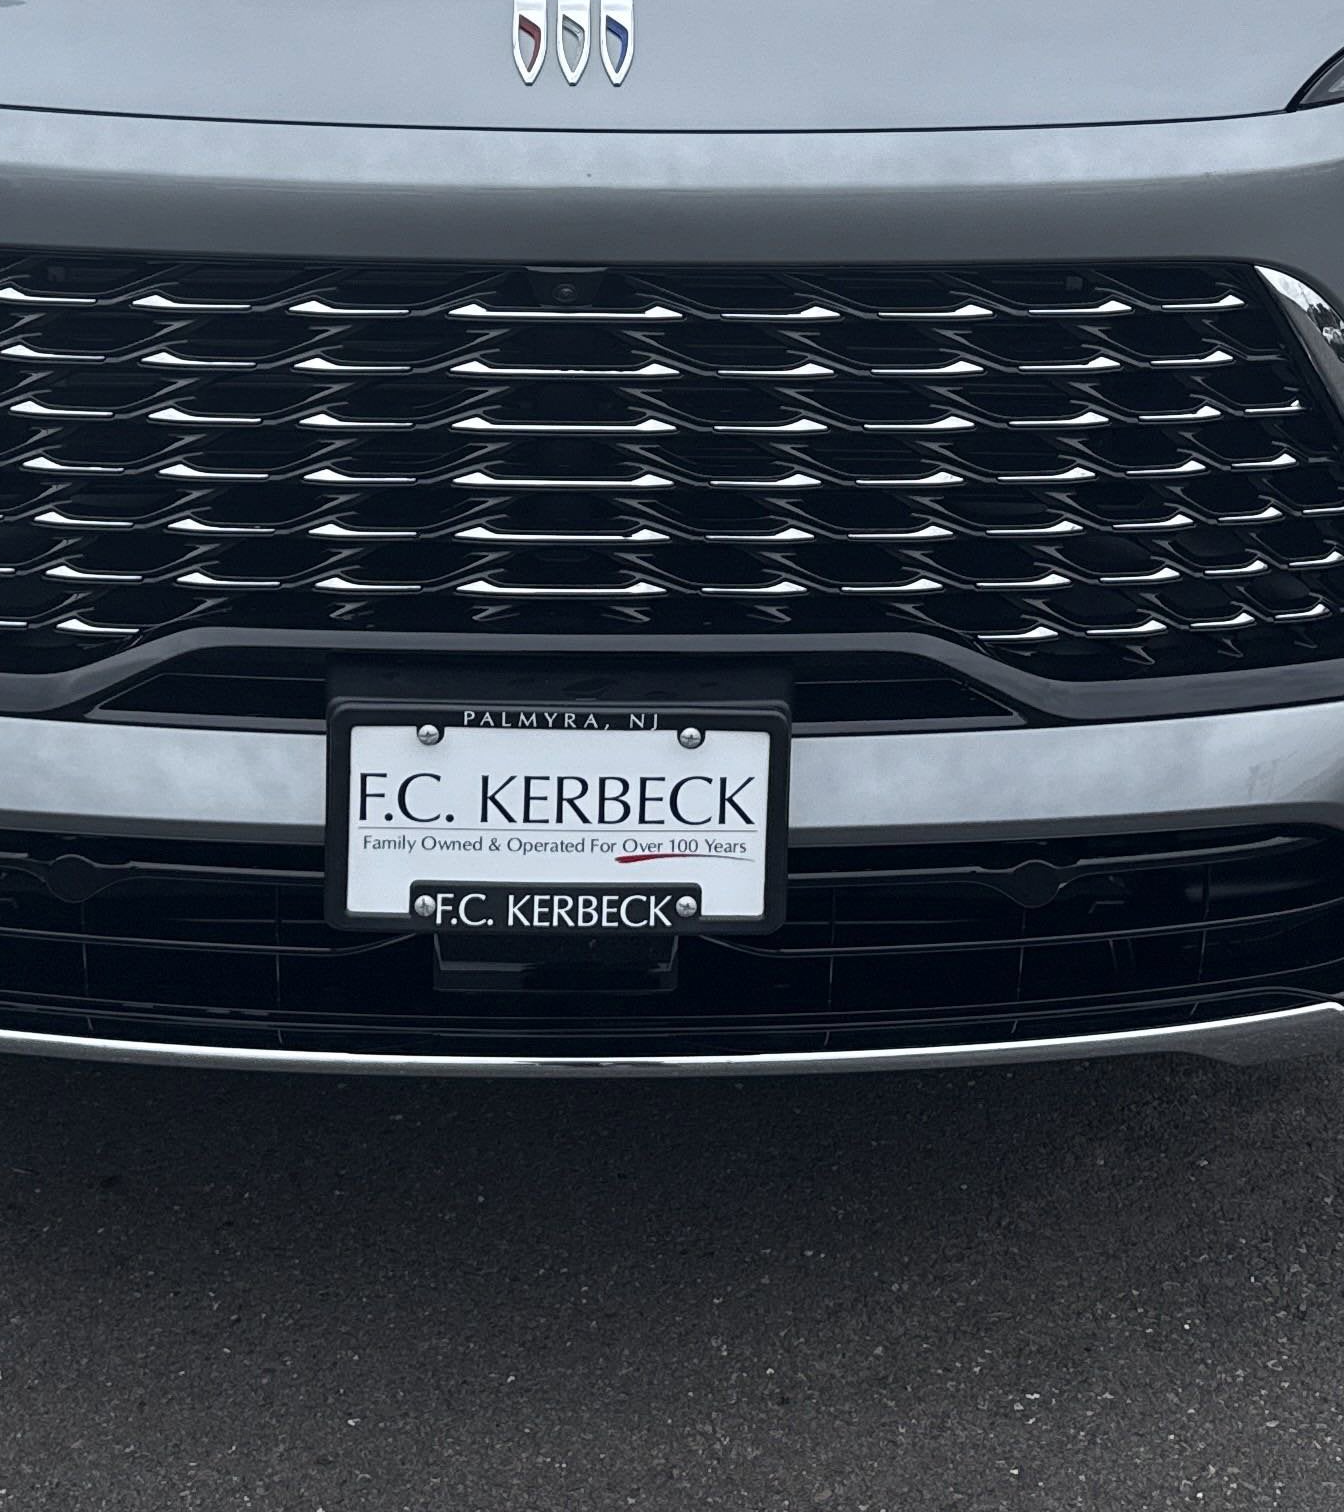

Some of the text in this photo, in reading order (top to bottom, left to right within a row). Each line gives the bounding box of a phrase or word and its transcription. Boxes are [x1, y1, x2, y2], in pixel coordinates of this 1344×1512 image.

[463, 711, 659, 731] PALMYRA, NJ
[359, 773, 756, 826] F.C. KERBECK
[363, 834, 747, 856] Family Owned & Operated For Over 100 Years
[435, 893, 673, 928] F.C. KERBECK
